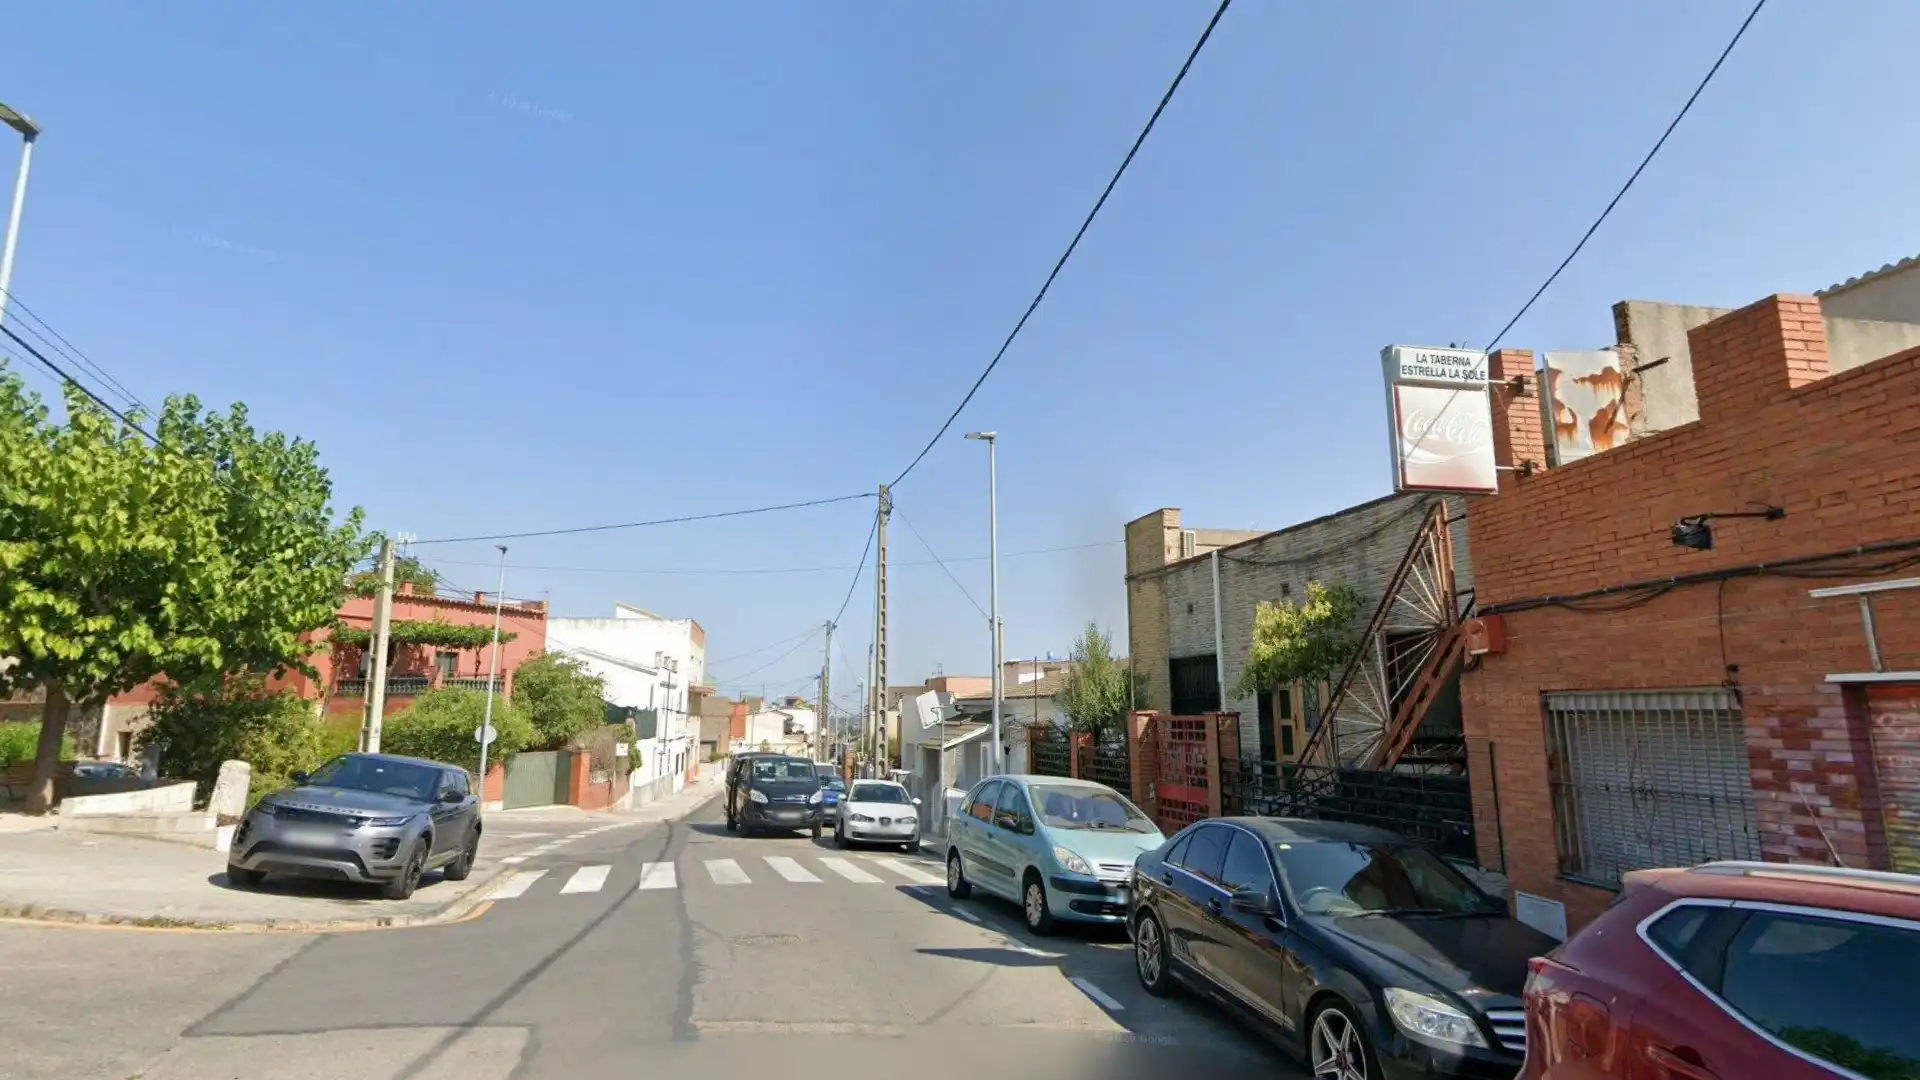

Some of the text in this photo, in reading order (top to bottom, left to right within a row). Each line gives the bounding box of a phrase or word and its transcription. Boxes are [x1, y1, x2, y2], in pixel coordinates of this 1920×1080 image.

[1415, 352, 1471, 367] LA TABERNA
[1401, 364, 1487, 381] ESTRELLA LA SOLE
